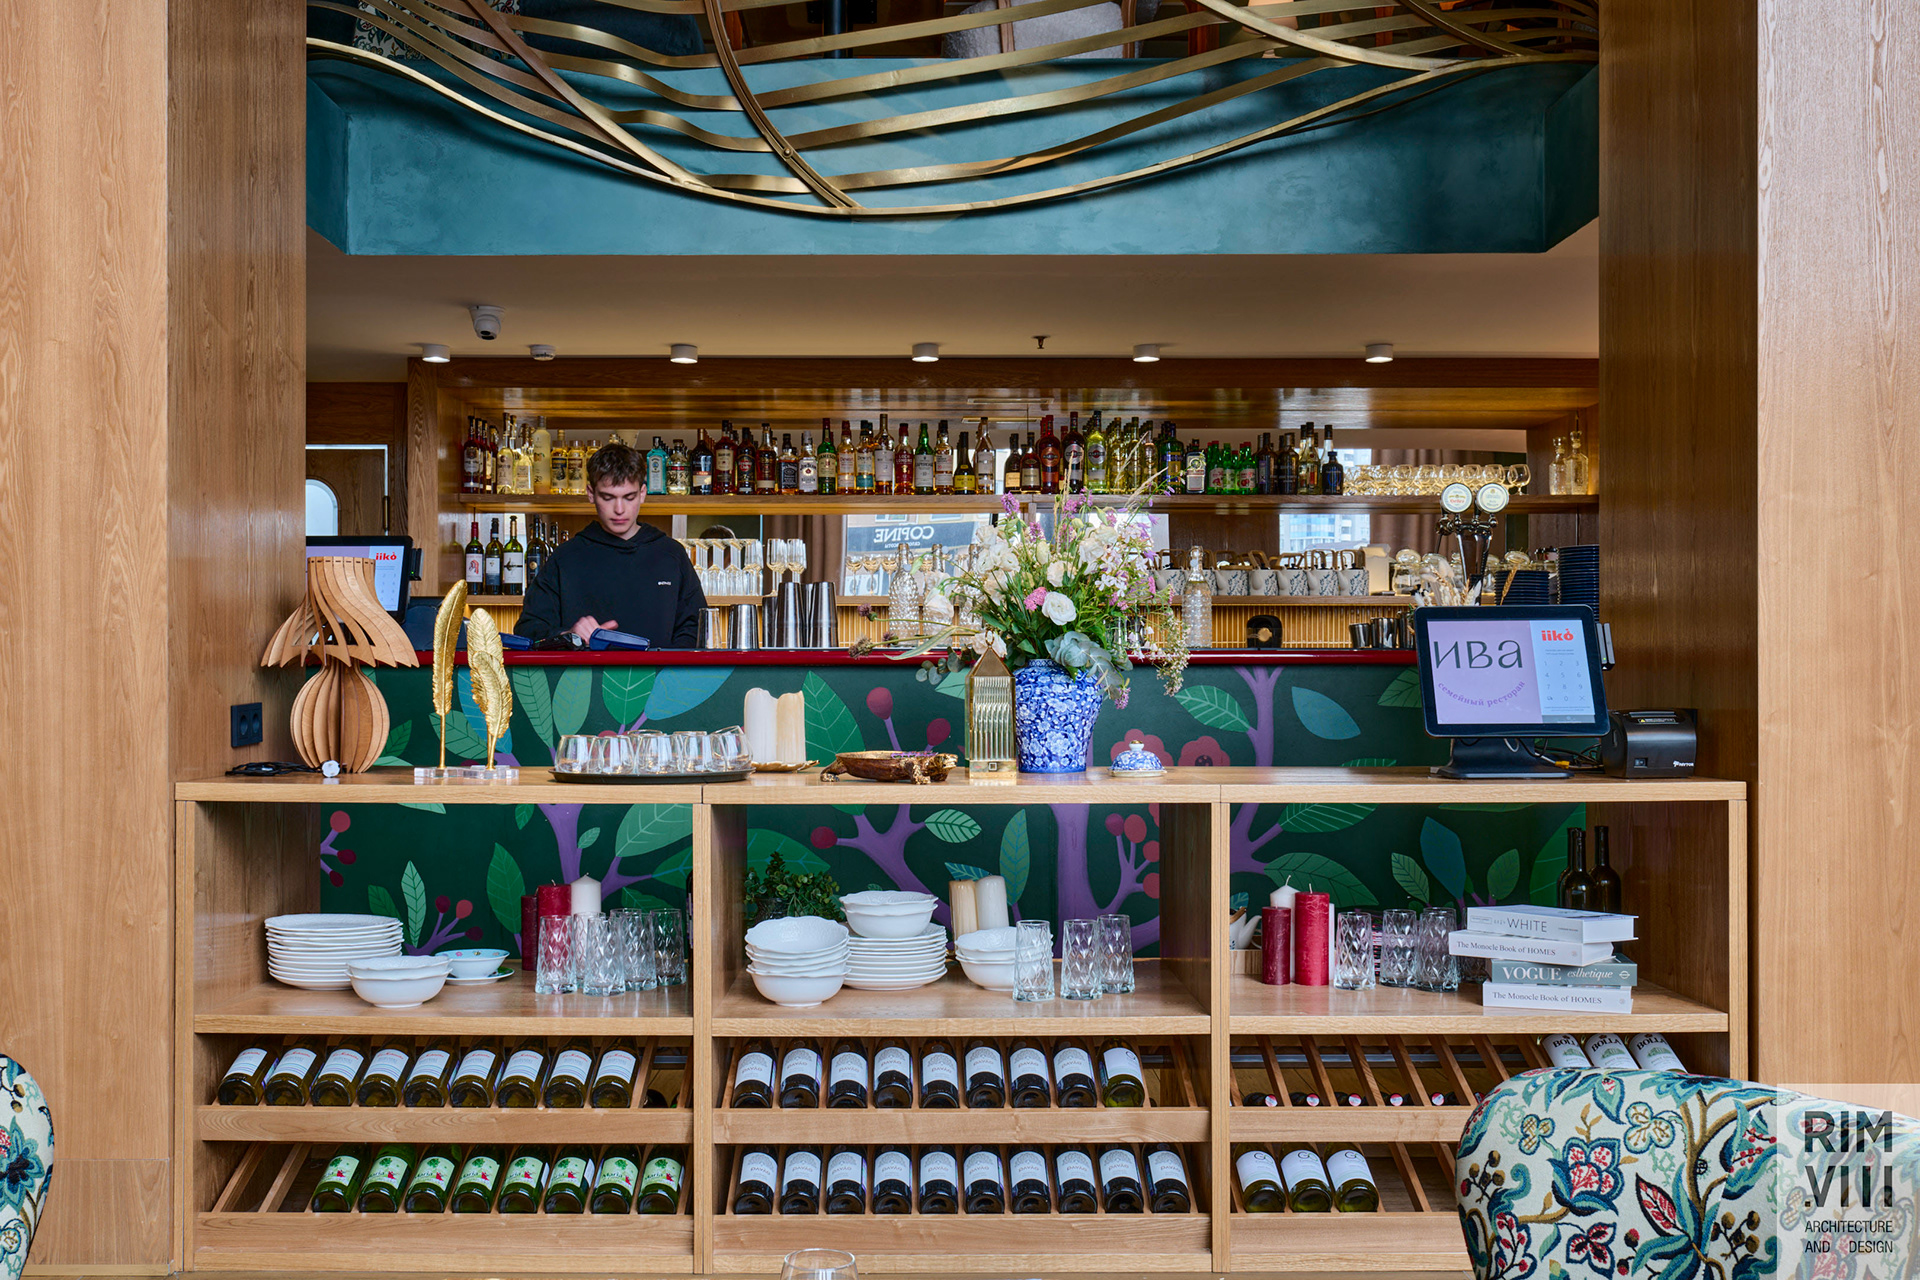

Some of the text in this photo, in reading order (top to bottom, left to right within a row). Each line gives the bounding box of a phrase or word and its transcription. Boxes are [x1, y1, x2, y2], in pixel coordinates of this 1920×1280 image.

[1541, 628, 1574, 641] iiko
[1438, 681, 1525, 708] семейный ресторан
[1507, 917, 1547, 933] WHITE
[1457, 941, 1469, 949] The
[1470, 942, 1499, 951] Monocle
[1500, 944, 1517, 952] Book
[1527, 948, 1557, 956] HOMES
[1502, 967, 1562, 980] VOGUE
[1508, 992, 1539, 1001] Monocle
[1570, 996, 1602, 1004] HOMES
[1591, 1038, 1623, 1052] BOLLA
